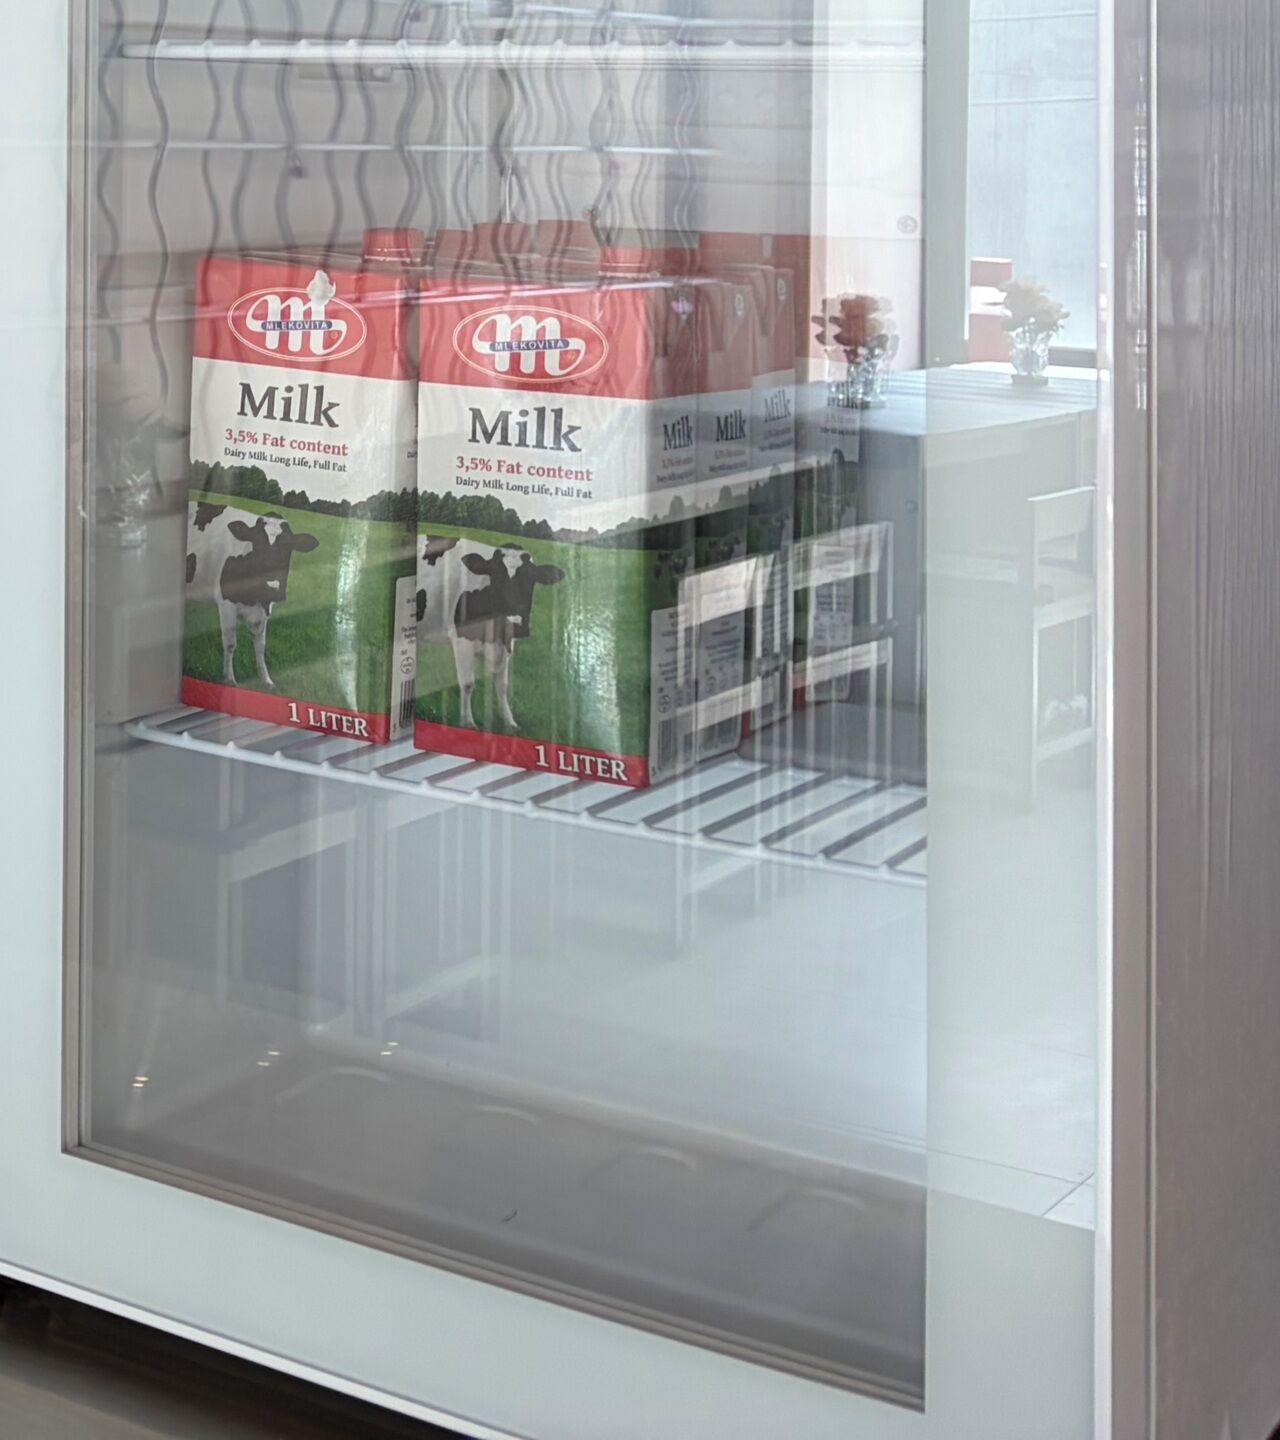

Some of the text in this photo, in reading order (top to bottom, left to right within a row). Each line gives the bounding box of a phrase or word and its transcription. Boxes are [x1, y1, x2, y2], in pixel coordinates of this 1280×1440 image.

[265, 320, 329, 331] MLEKOVITA
[494, 340, 565, 352] MLEKOVITA
[236, 381, 341, 429] Milk
[467, 405, 583, 453] Milk
[663, 414, 694, 452] Milk
[715, 408, 747, 443] Milk
[225, 428, 349, 457] 3,5% Fat content
[224, 447, 348, 473] Dairy Milk Long Life, Full Fat
[456, 456, 594, 482] 3,5% Fat content
[455, 476, 593, 499] Dairy Milk Long Life, Full Fat
[287, 702, 369, 738] 1 LITER
[535, 744, 629, 781] 1 LITER
